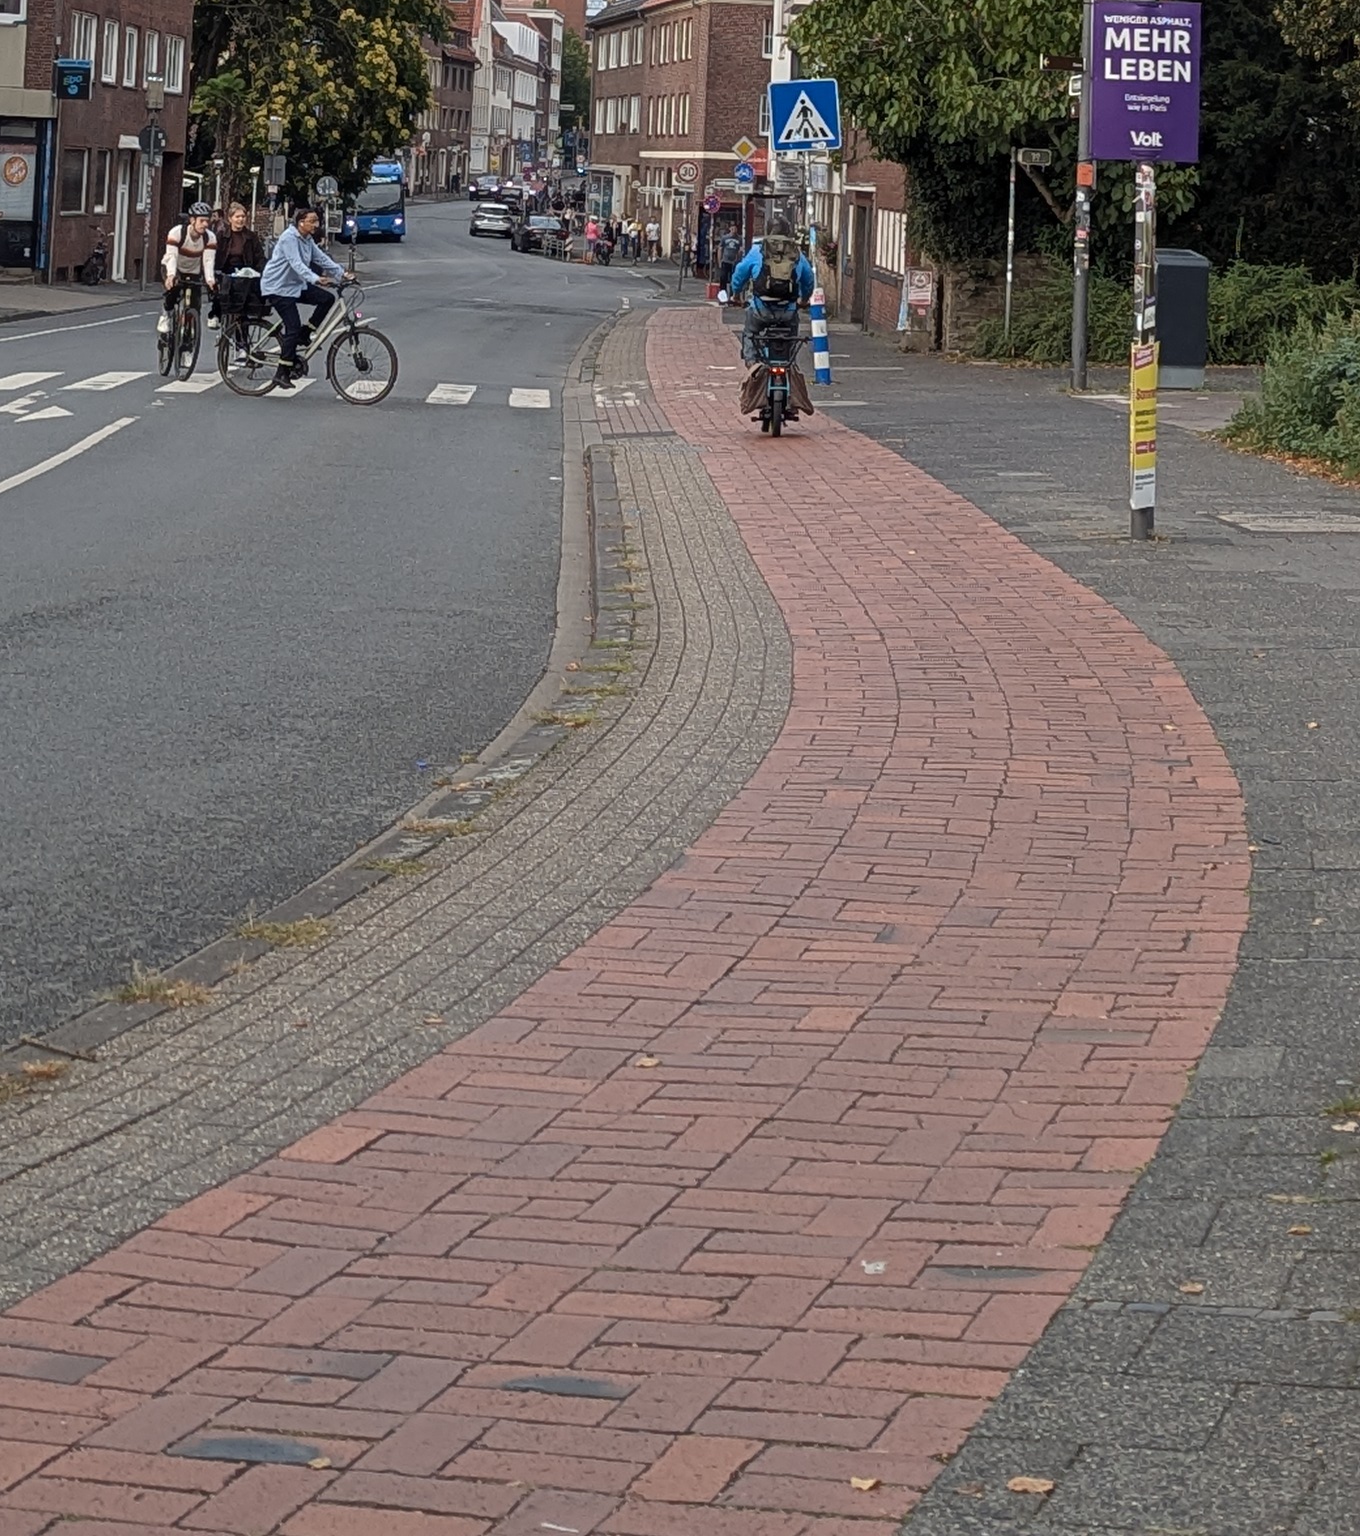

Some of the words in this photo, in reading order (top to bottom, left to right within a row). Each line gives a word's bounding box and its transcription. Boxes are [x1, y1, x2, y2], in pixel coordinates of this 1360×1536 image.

[1104, 15, 1148, 24] WENIGER
[1150, 17, 1192, 28] ASPHALT,
[1104, 27, 1191, 54] MEHR
[1104, 58, 1192, 82] LEBEN
[1124, 93, 1170, 104] Entsiegelung
[1150, 104, 1167, 112] Paris
[1130, 131, 1163, 147] Volt
